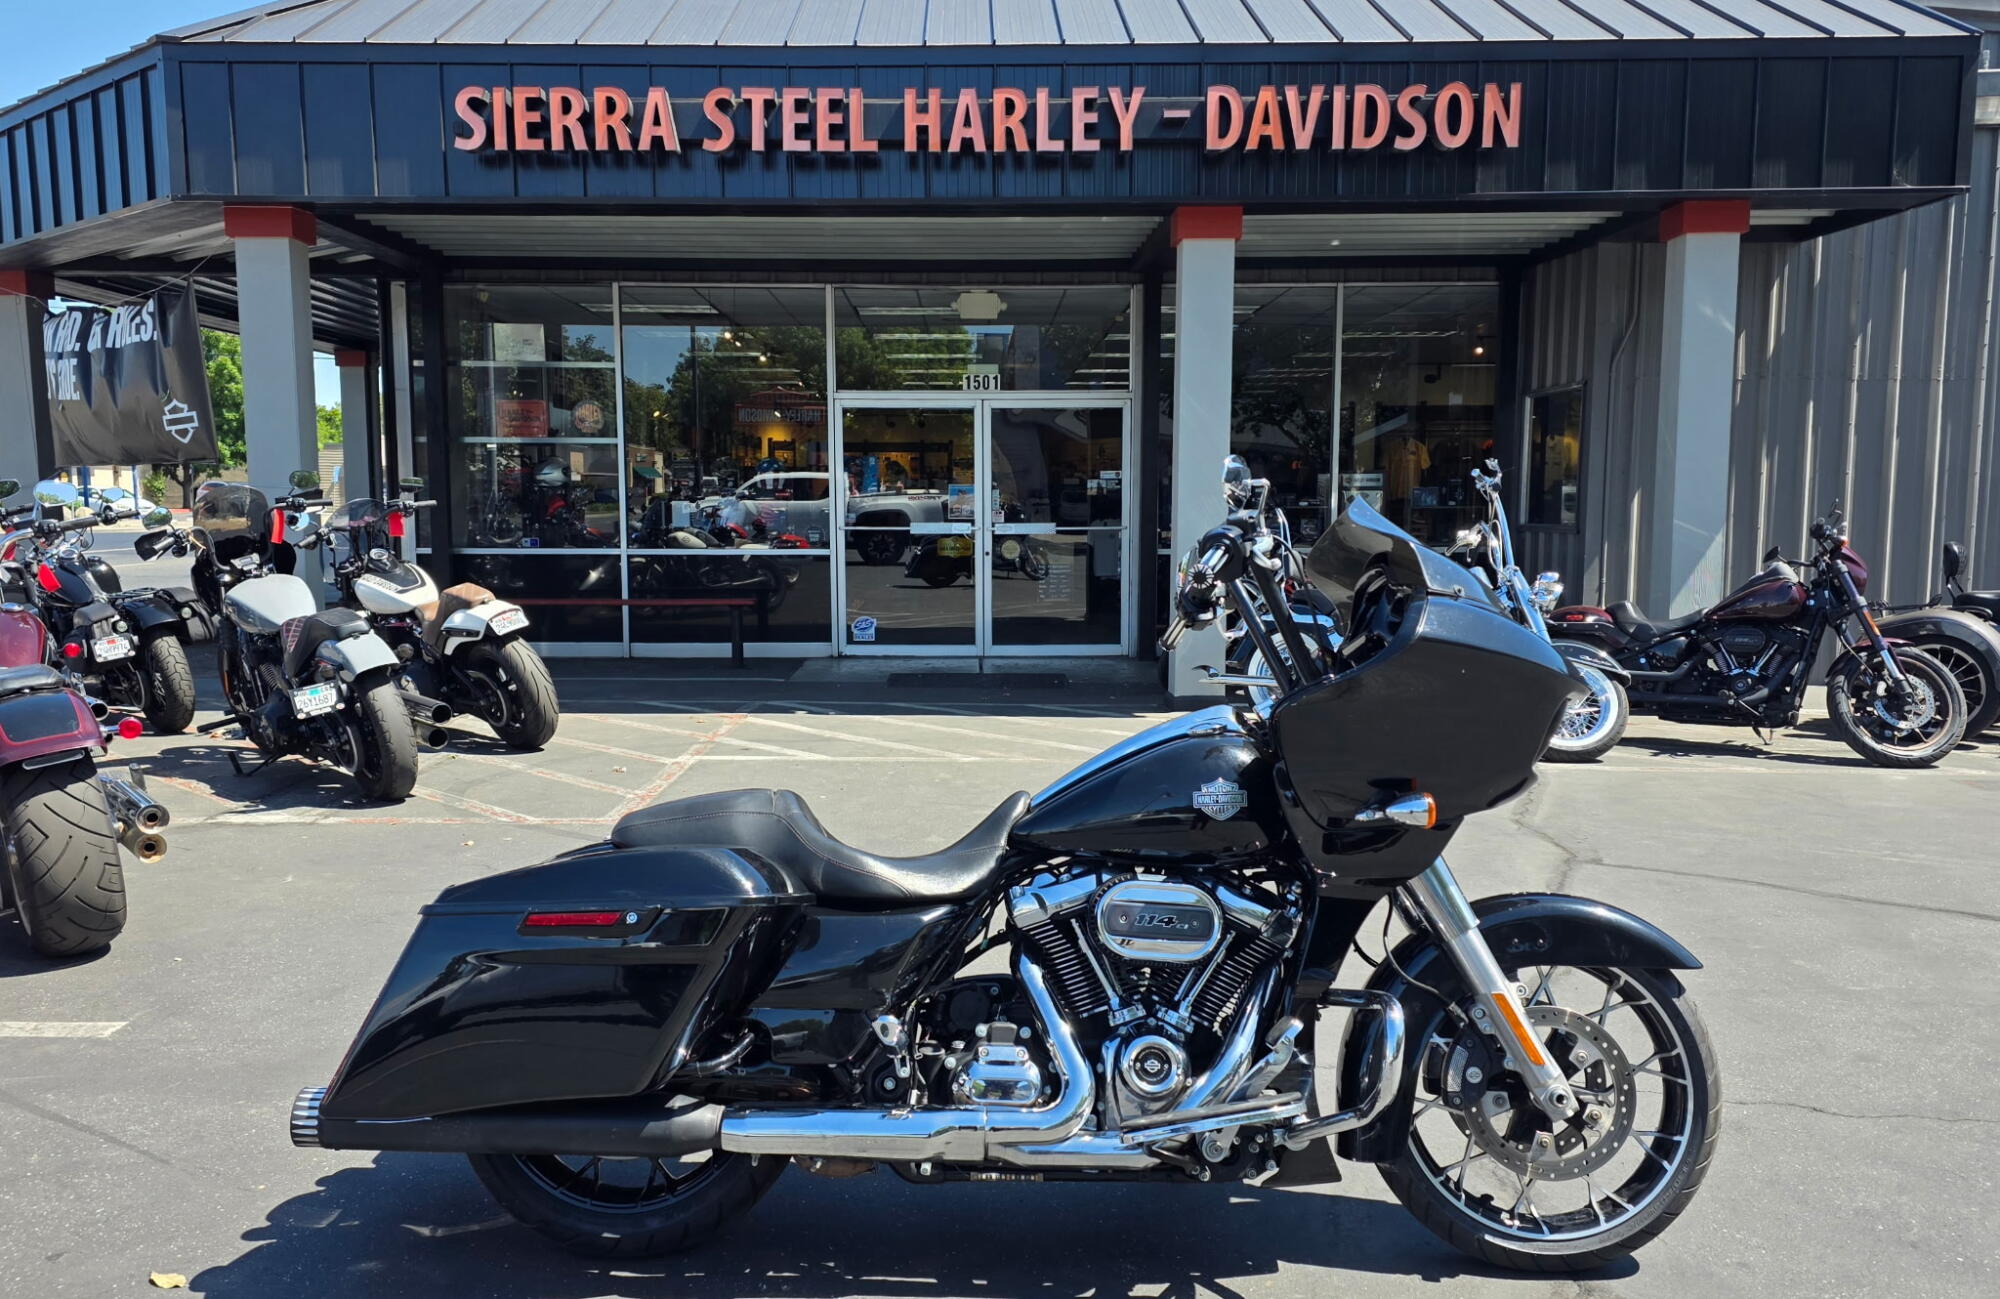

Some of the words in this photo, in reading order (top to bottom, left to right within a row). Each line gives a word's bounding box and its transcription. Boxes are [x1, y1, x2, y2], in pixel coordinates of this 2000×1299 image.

[454, 86, 680, 152] SIERRA
[702, 87, 879, 152] STEEL
[904, 86, 1146, 152] HARLEY
[1205, 82, 1522, 150] DAVIDSON
[965, 374, 998, 390] 1501
